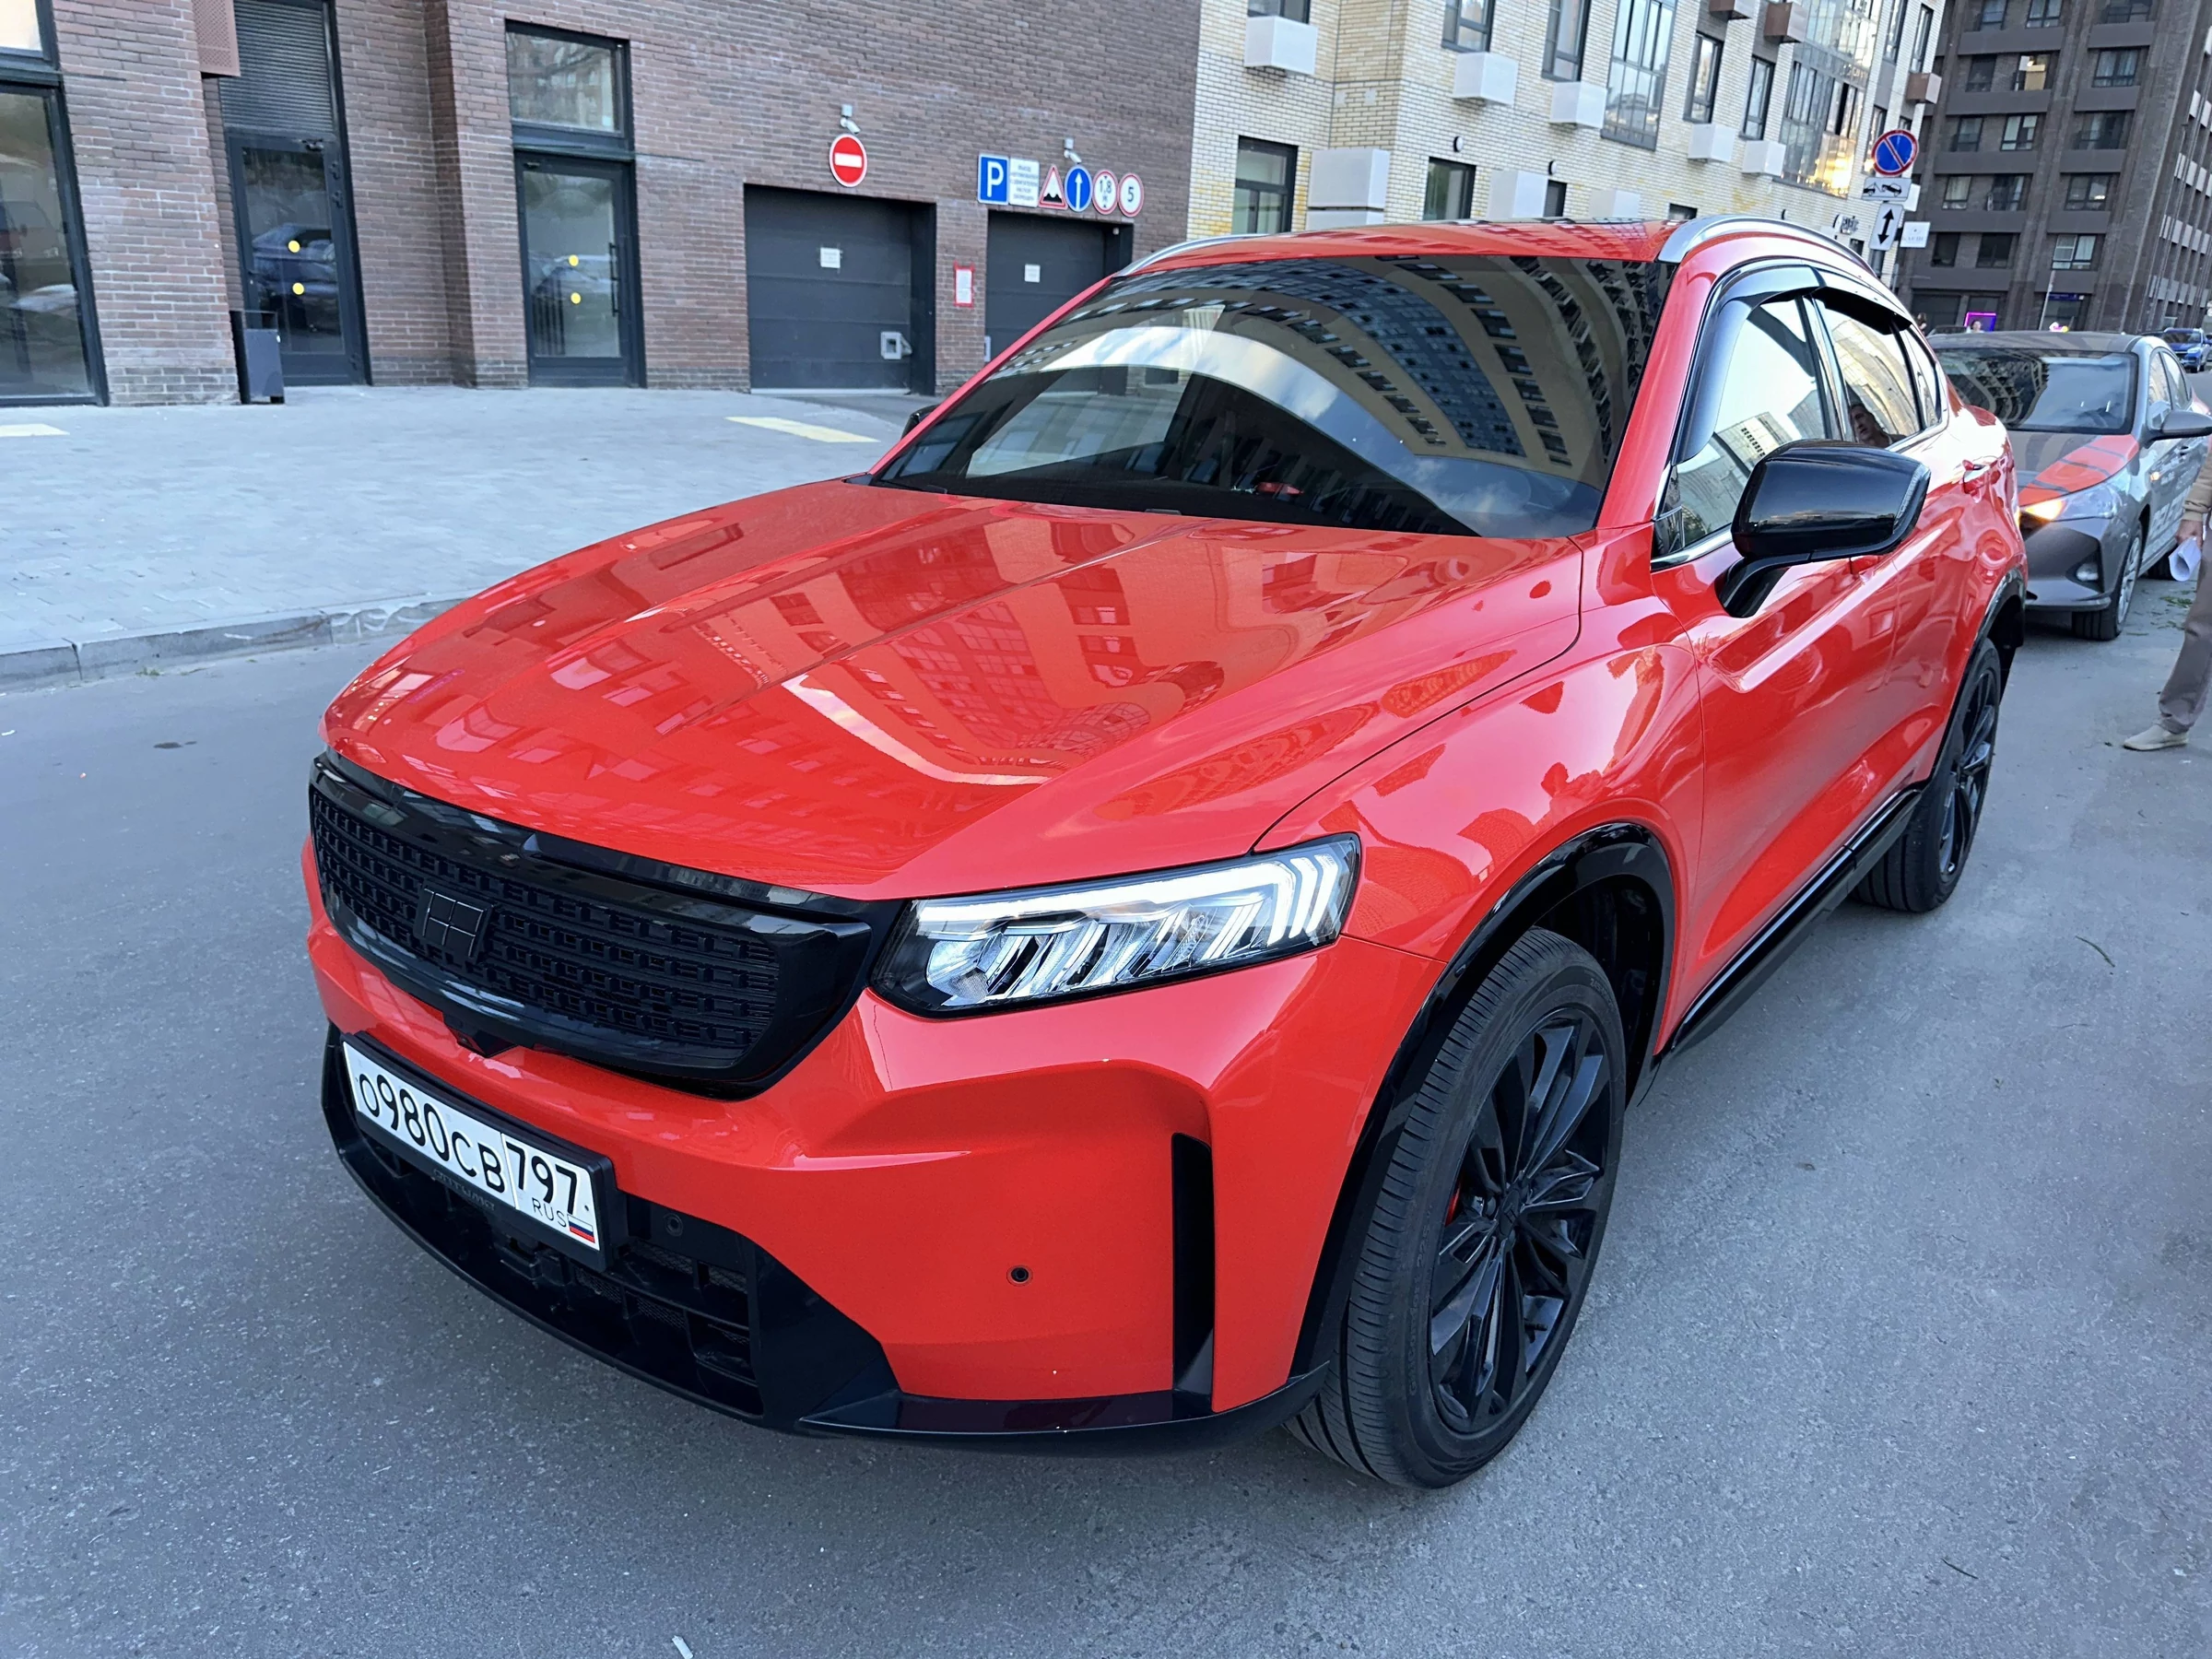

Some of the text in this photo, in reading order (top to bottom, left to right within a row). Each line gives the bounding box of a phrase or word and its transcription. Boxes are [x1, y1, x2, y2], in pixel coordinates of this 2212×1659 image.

[986, 160, 1005, 198] P
[1126, 186, 1135, 203] 5
[506, 1140, 578, 1216] 797
[532, 1197, 567, 1229] RUS
